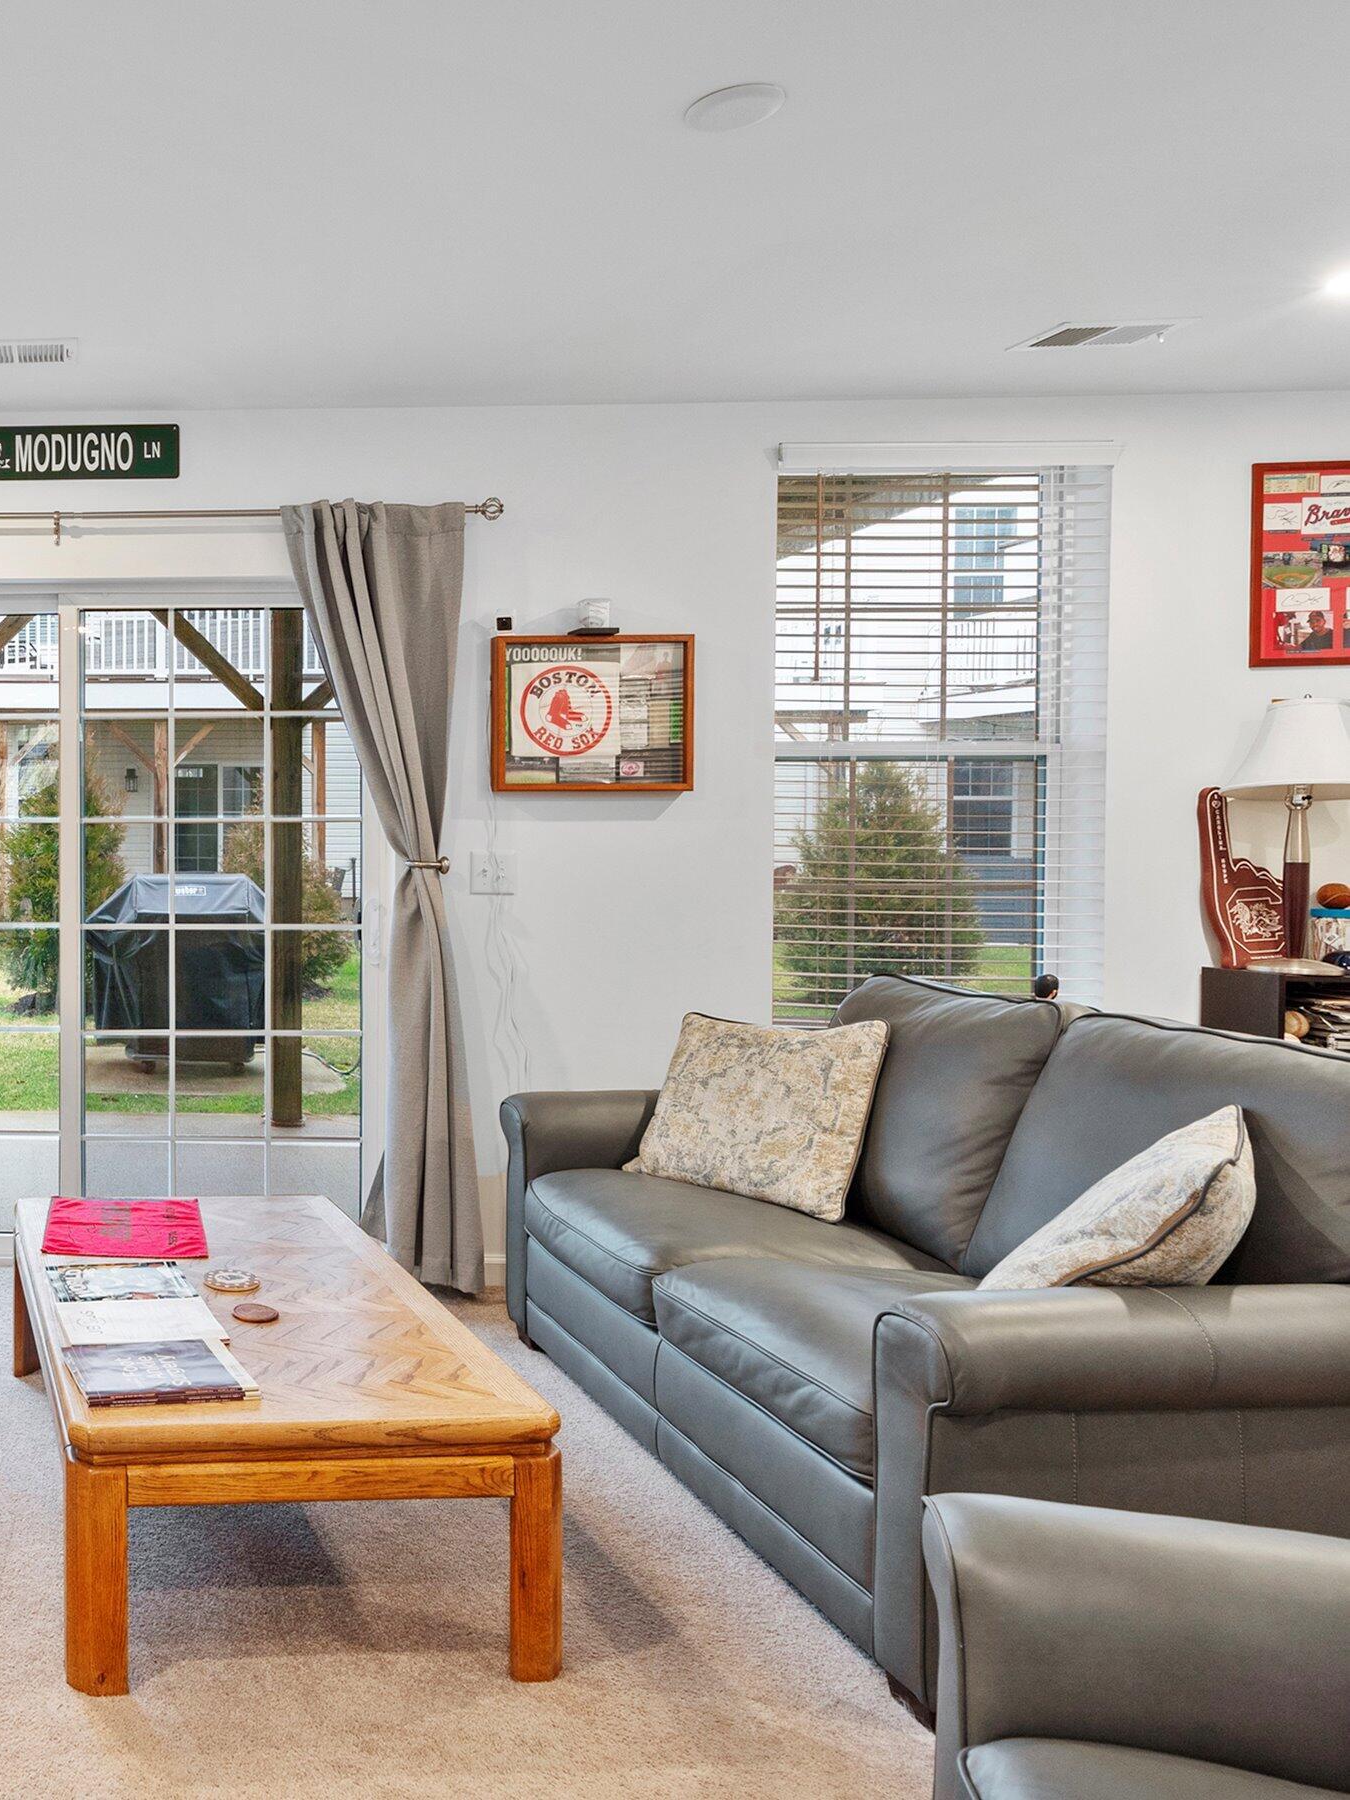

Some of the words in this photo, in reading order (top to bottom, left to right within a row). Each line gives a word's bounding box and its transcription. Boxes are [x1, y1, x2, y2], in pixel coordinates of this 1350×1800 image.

[14, 431, 134, 473] MODUGNO
[143, 441, 161, 459] LN
[529, 671, 602, 699] BOSTON
[534, 726, 563, 750] RED
[571, 727, 600, 750] SOX
